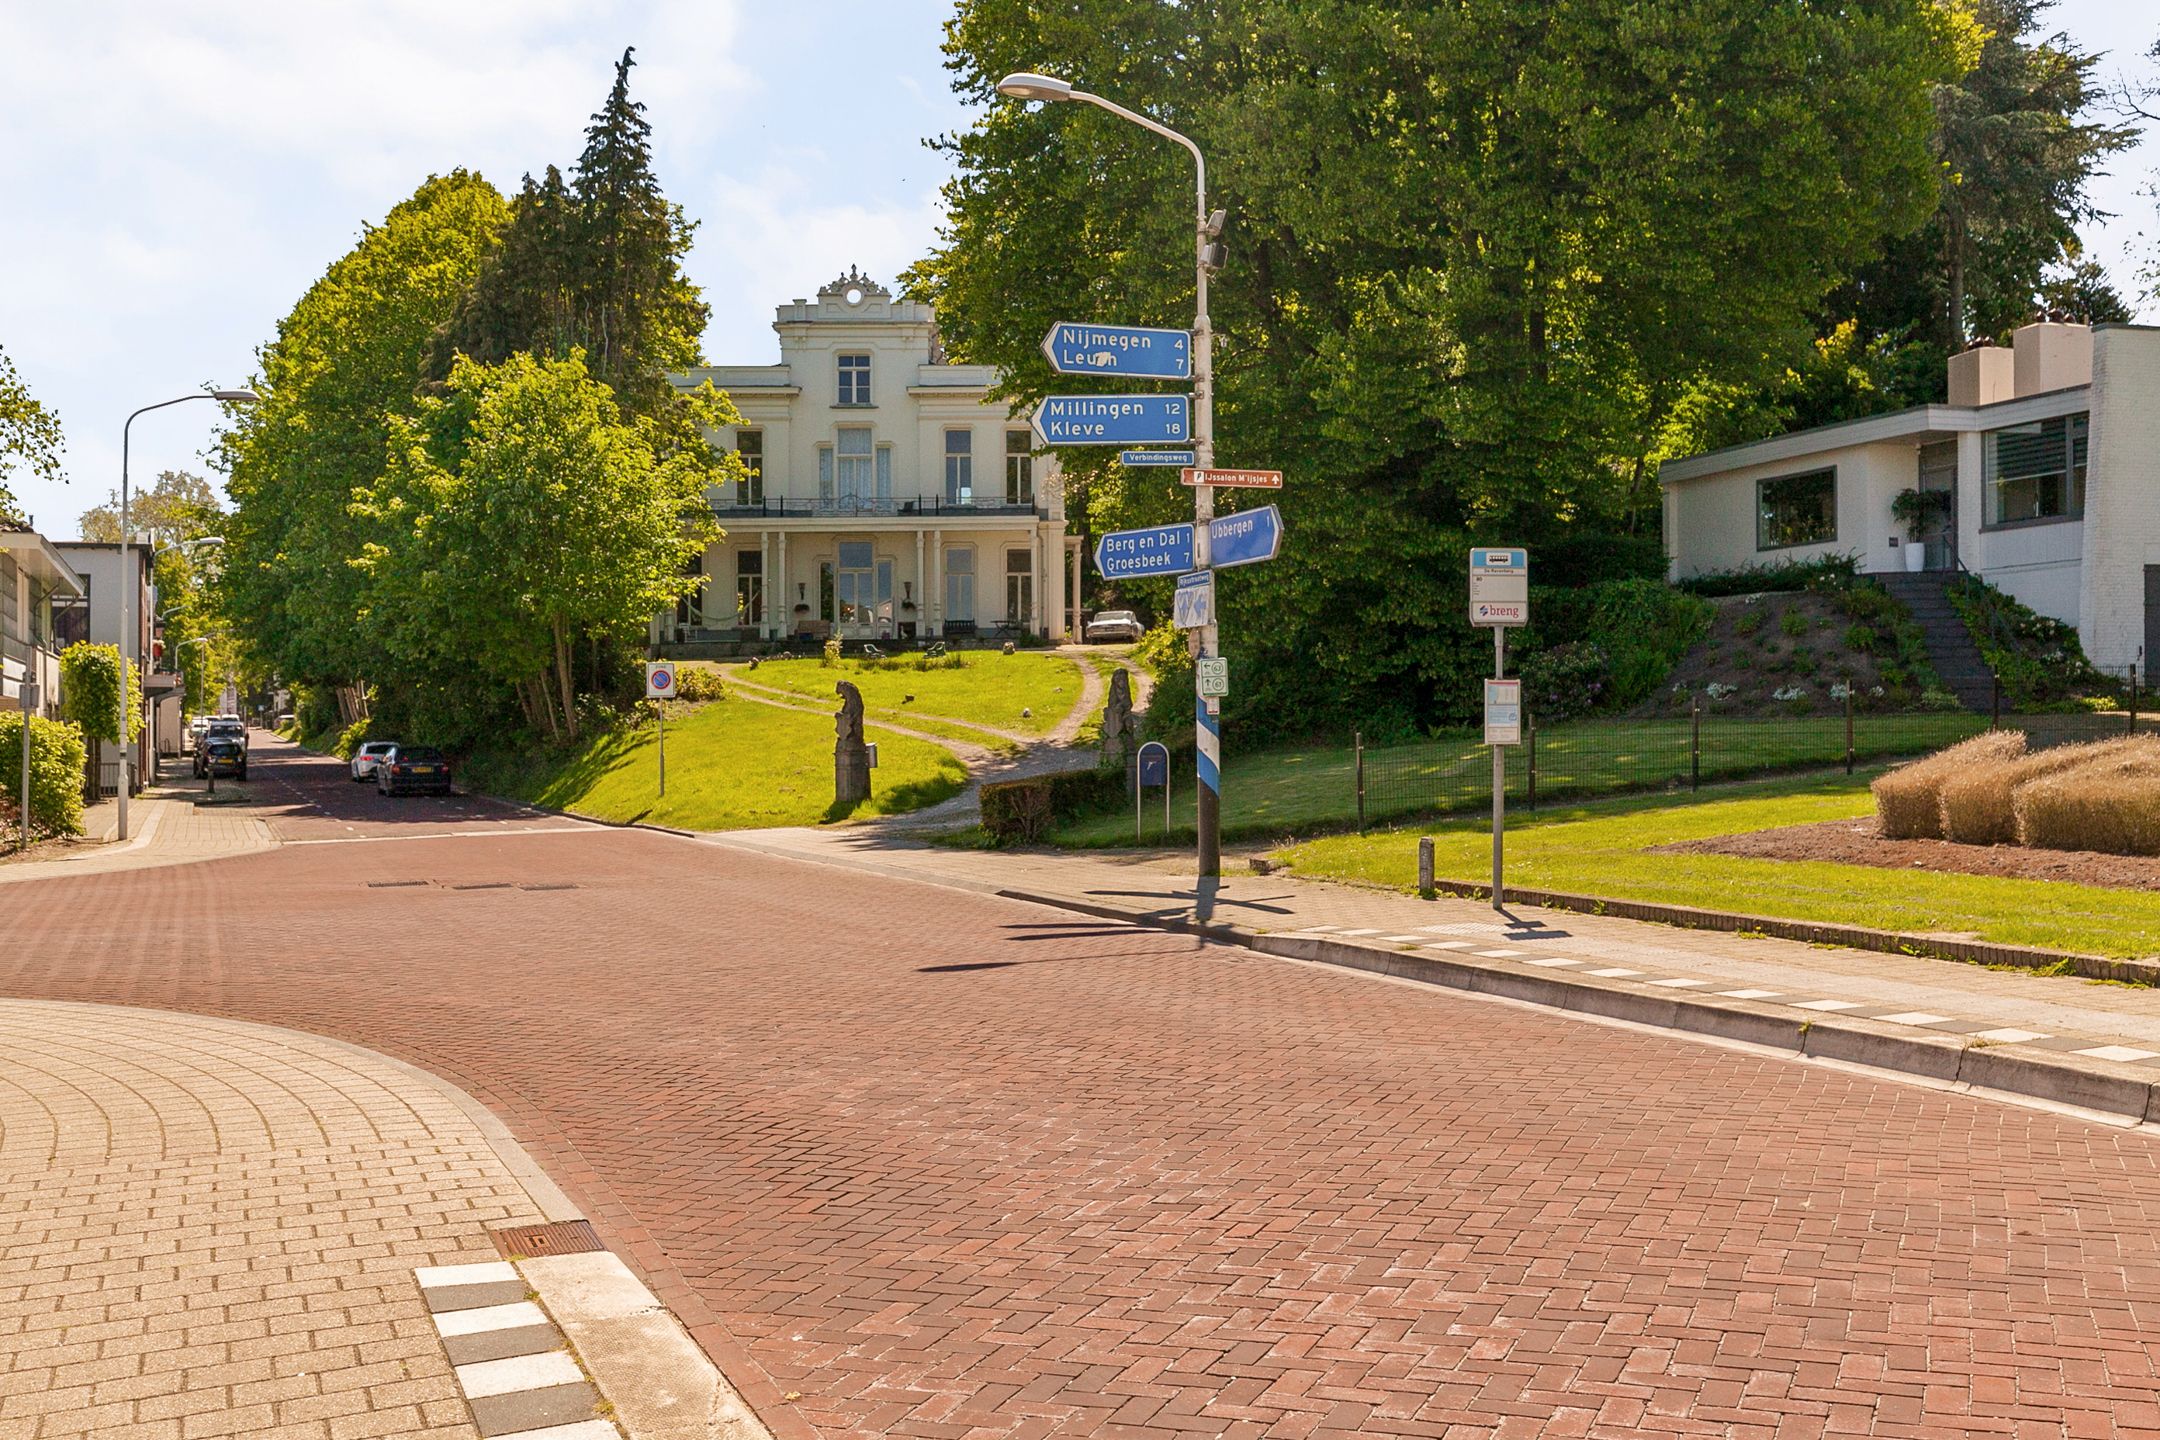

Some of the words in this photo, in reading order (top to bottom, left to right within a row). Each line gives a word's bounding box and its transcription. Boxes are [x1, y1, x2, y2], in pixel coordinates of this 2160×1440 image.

[1063, 329, 1151, 351] Nijmegen
[1174, 339, 1184, 350] 4
[1063, 349, 1117, 366] Leuh
[1176, 358, 1184, 370] 7
[1050, 402, 1143, 419] Millingen
[1164, 403, 1180, 415] 12
[1051, 421, 1104, 436] Kleve
[1165, 423, 1181, 434] 18
[1129, 453, 1187, 463] Verbindingsweg
[1205, 473, 1236, 482] IJssalon
[1211, 518, 1253, 539] Ubbergen
[1266, 516, 1270, 528] 1
[1106, 538, 1135, 553] Berg
[1139, 537, 1154, 548] en
[1159, 531, 1180, 546] Dal
[1186, 532, 1190, 543] 1
[1107, 552, 1171, 571] Groesbeek
[1183, 552, 1190, 563] 7
[1489, 604, 1519, 618] breng
